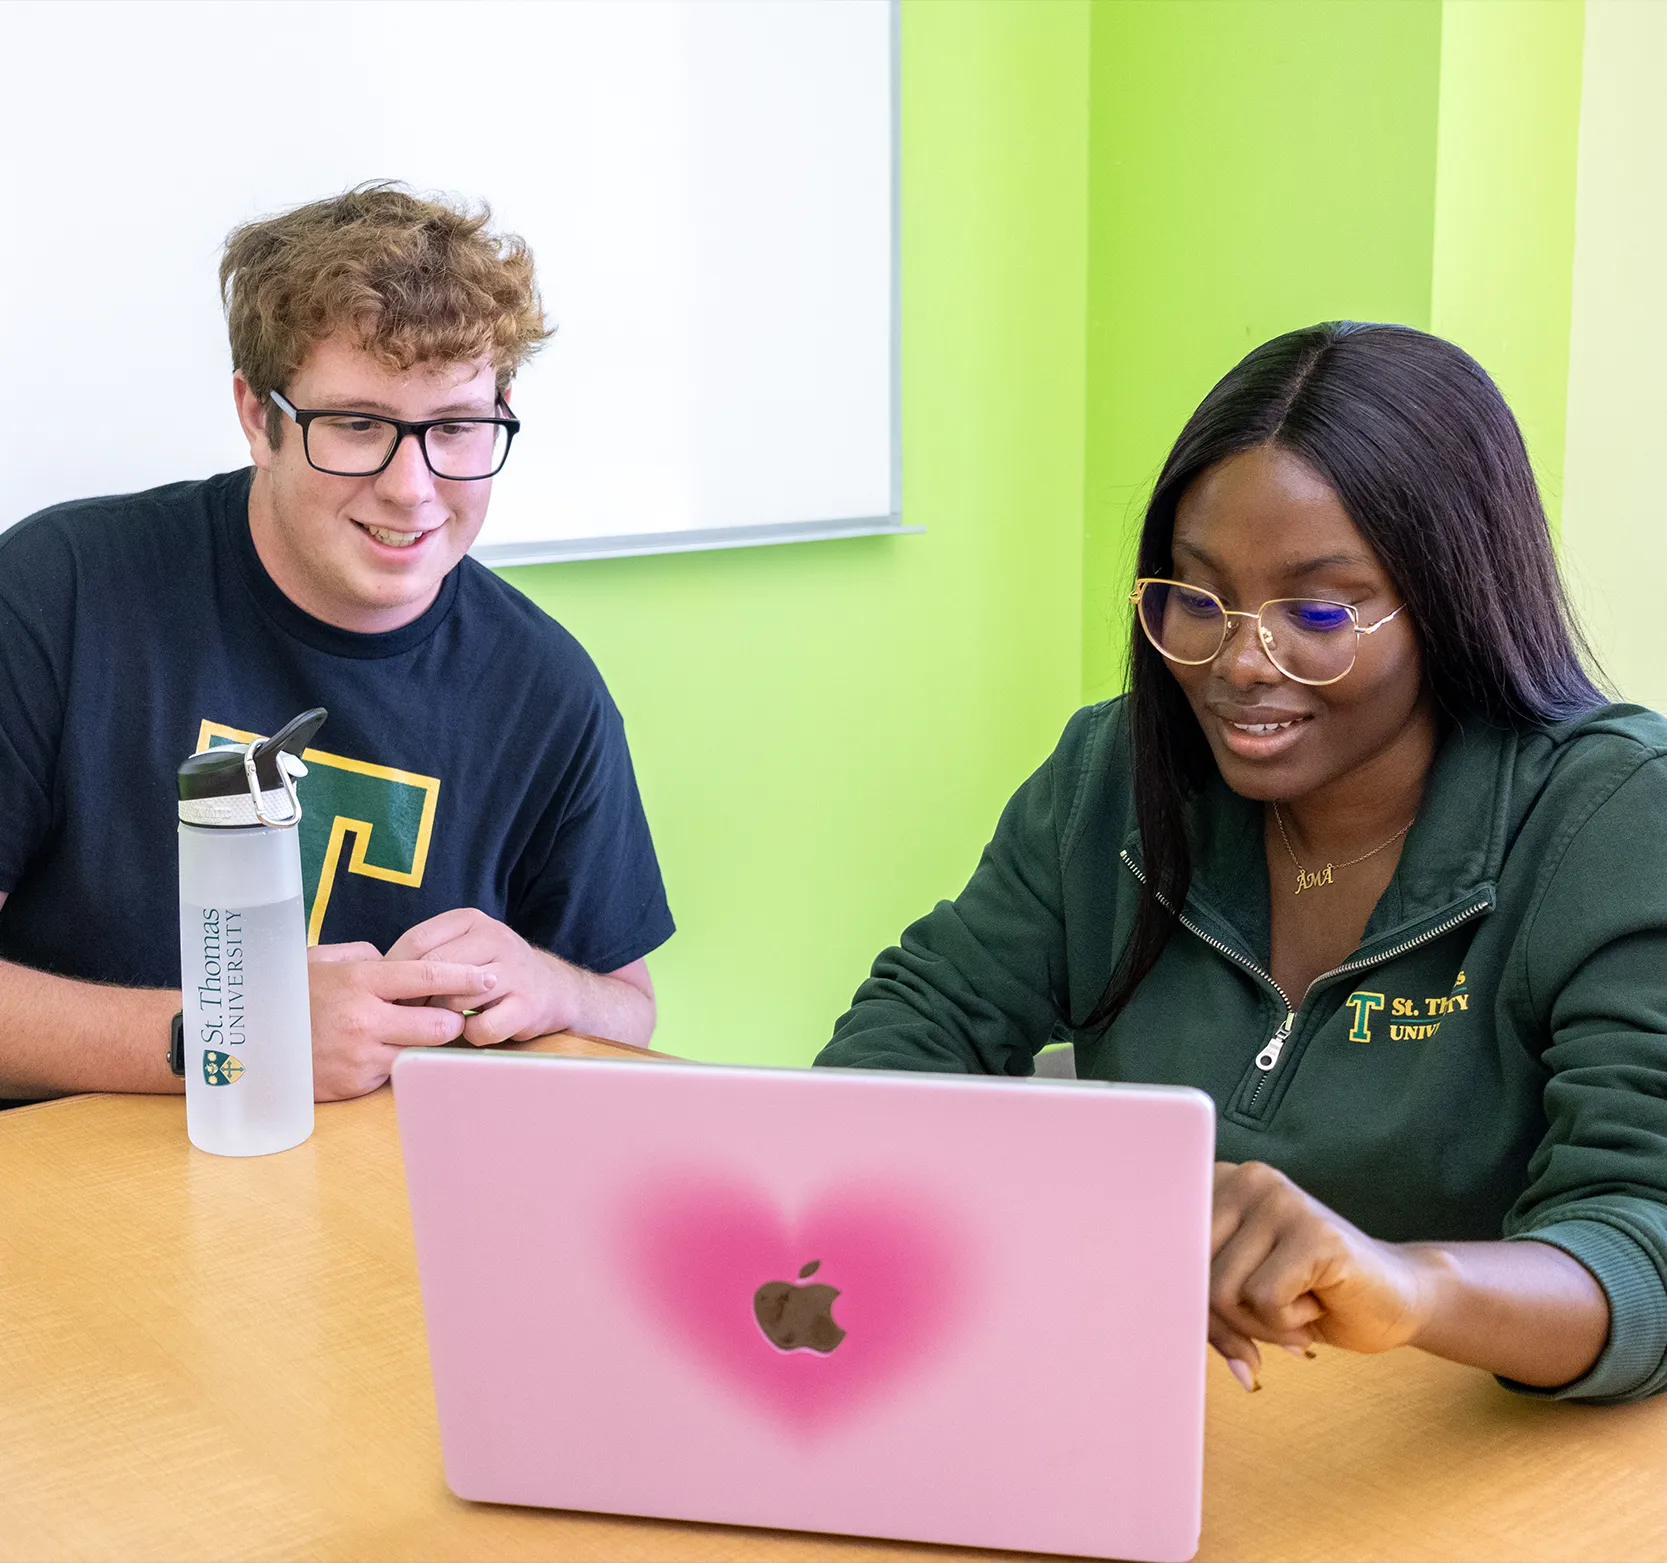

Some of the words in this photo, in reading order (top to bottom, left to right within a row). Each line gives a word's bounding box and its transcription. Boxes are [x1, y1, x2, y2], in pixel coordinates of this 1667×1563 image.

[1295, 864, 1334, 895] AMA
[198, 908, 223, 1012] Thomas
[226, 909, 246, 1046] UNIVERSITY
[1345, 991, 1385, 1043] T
[1391, 998, 1419, 1016] St.
[200, 1015, 224, 1045] St.
